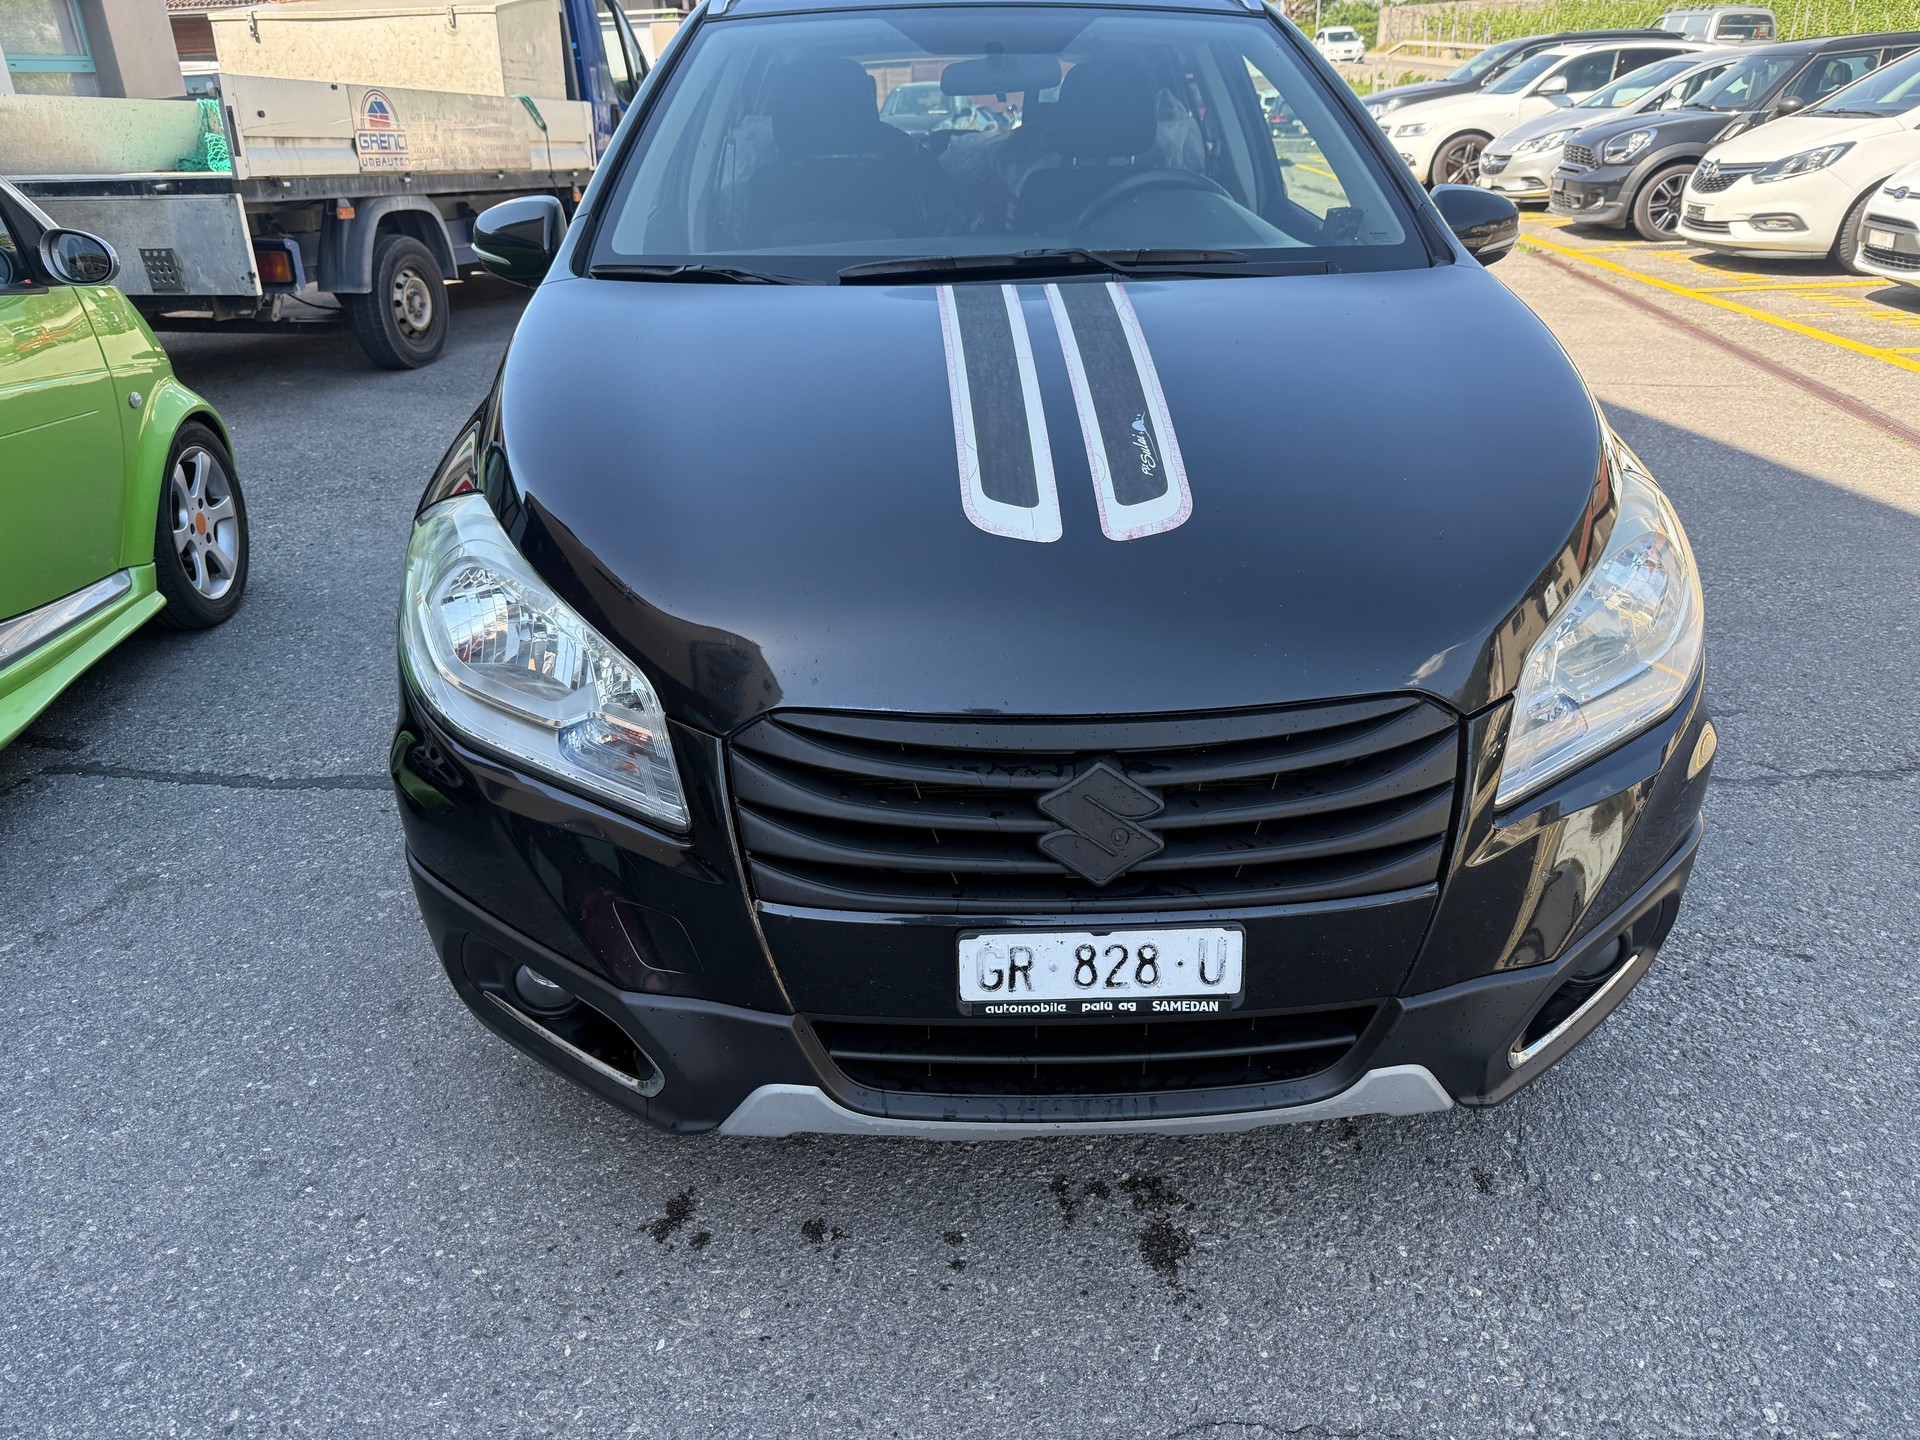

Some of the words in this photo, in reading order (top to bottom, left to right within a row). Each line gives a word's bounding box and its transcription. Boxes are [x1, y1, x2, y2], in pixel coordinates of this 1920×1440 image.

[976, 944, 1036, 993] GR
[1073, 943, 1161, 990] 828
[1198, 937, 1227, 987] U
[985, 1003, 1067, 1014] automobile
[1118, 1002, 1136, 1013] ag
[1152, 1000, 1219, 1012] SAMEDAN
